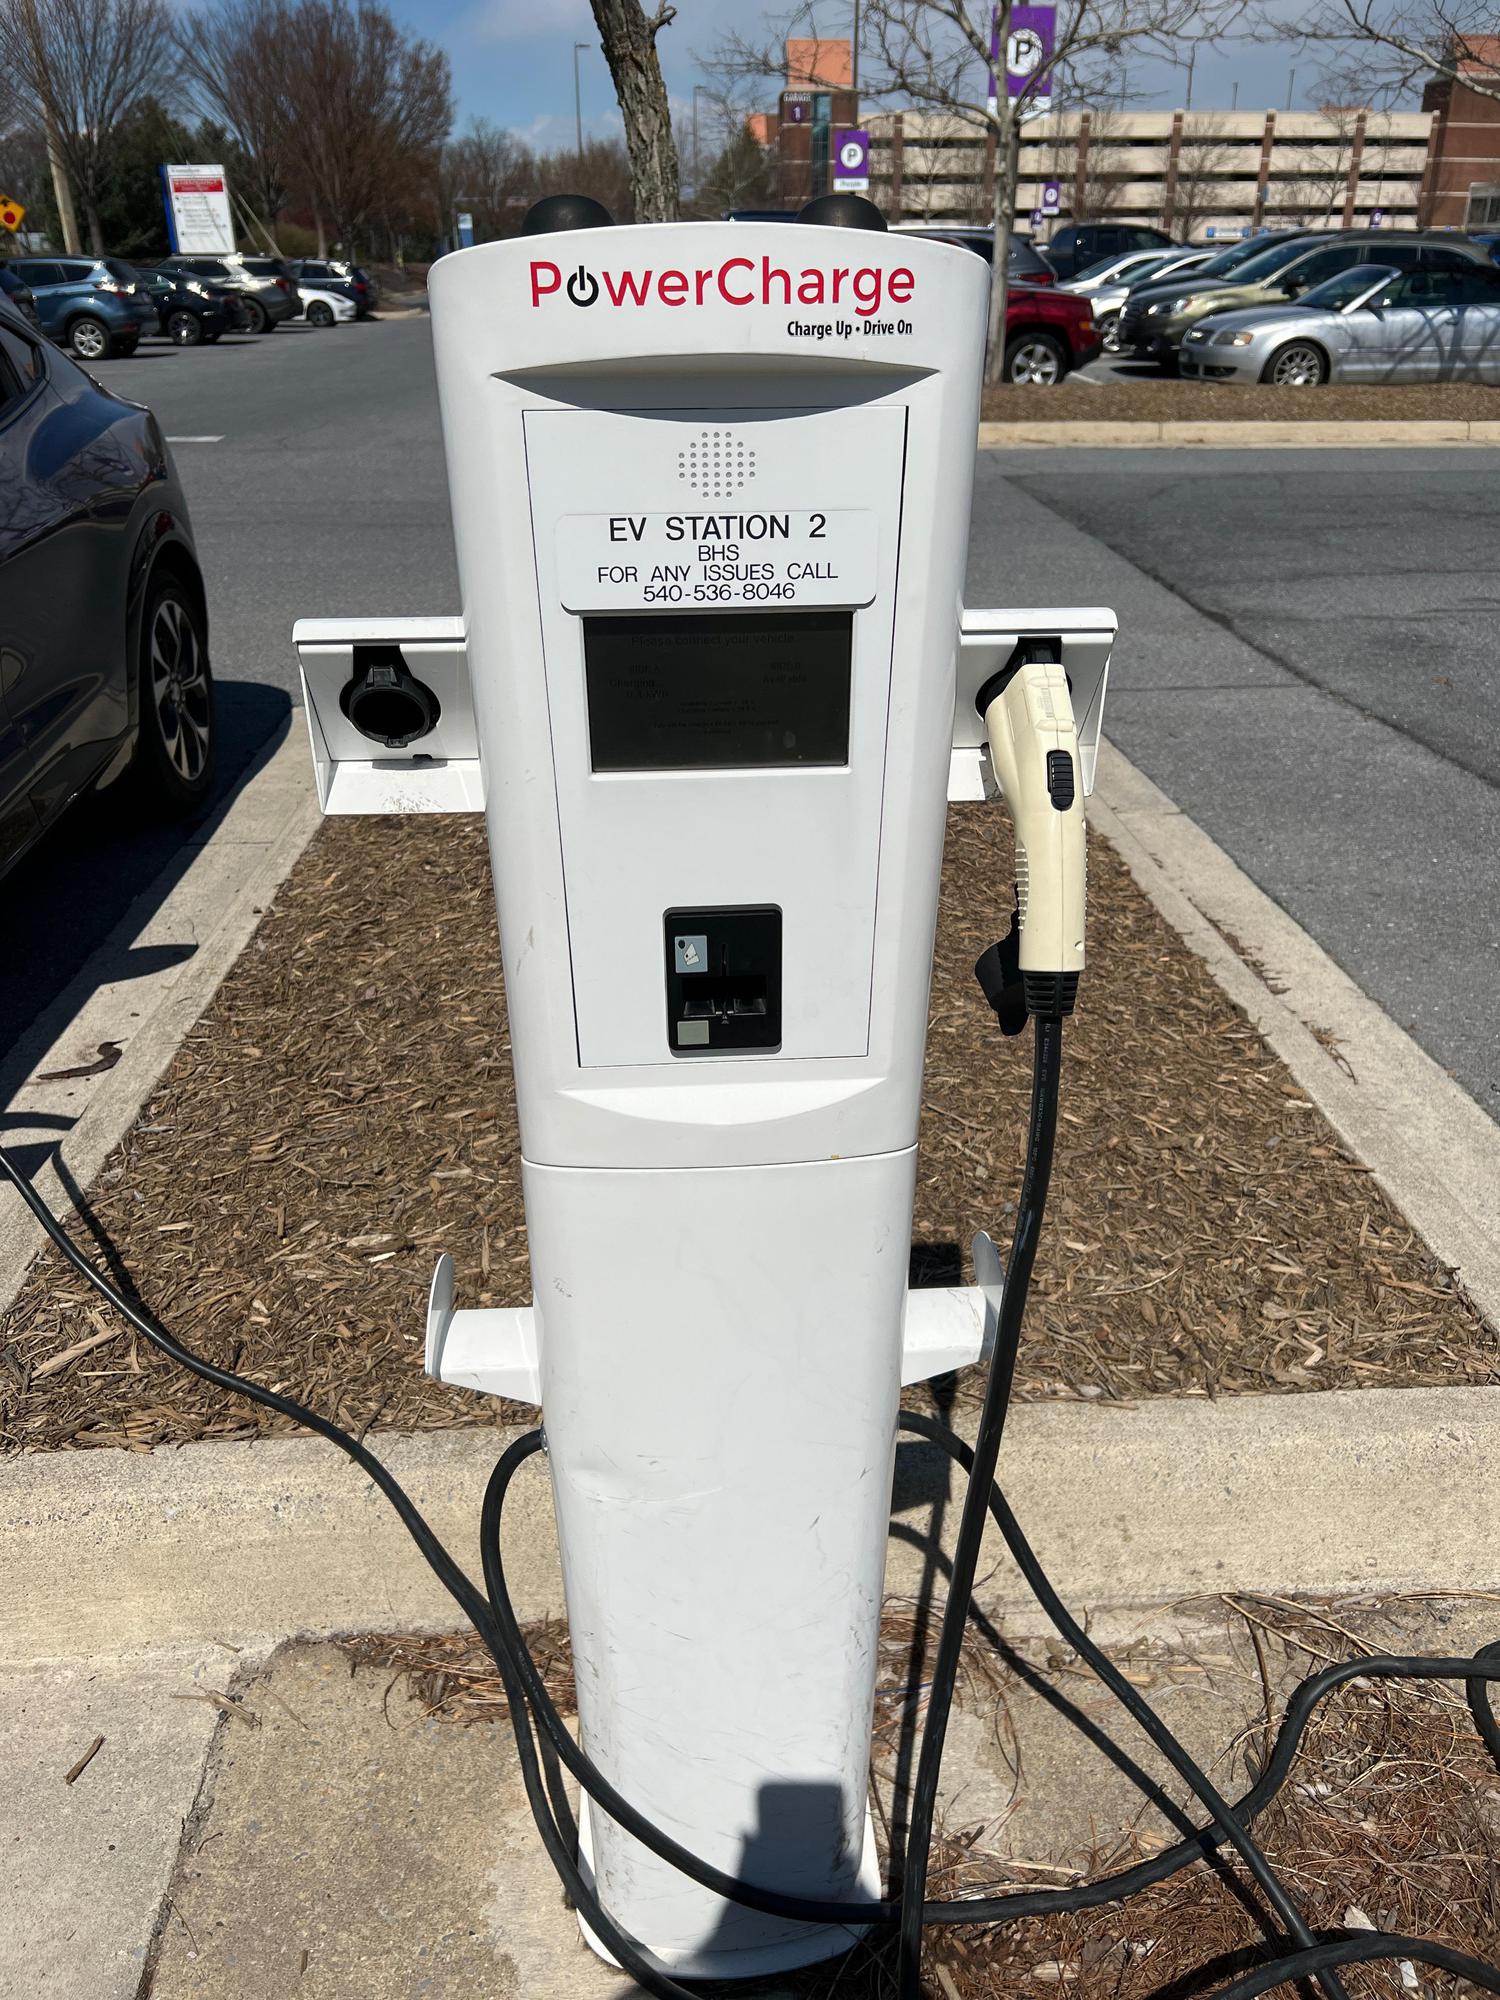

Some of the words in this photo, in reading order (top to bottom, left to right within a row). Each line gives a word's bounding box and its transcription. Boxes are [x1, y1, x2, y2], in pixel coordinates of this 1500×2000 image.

[847, 148, 858, 162] P
[529, 256, 915, 317] PowerCharge
[787, 320, 832, 340] Charge
[836, 320, 853, 340] Up
[863, 319, 895, 335] Drive
[897, 319, 913, 335] On
[609, 516, 646, 542] EV
[665, 514, 790, 541] STATION
[809, 513, 826, 538] 2
[698, 544, 740, 561] BHS
[597, 566, 638, 583] FOR
[650, 565, 691, 582] ANY
[703, 563, 775, 582] ISSUES
[786, 562, 839, 580] CALL
[643, 583, 796, 601] 540-536-8046
